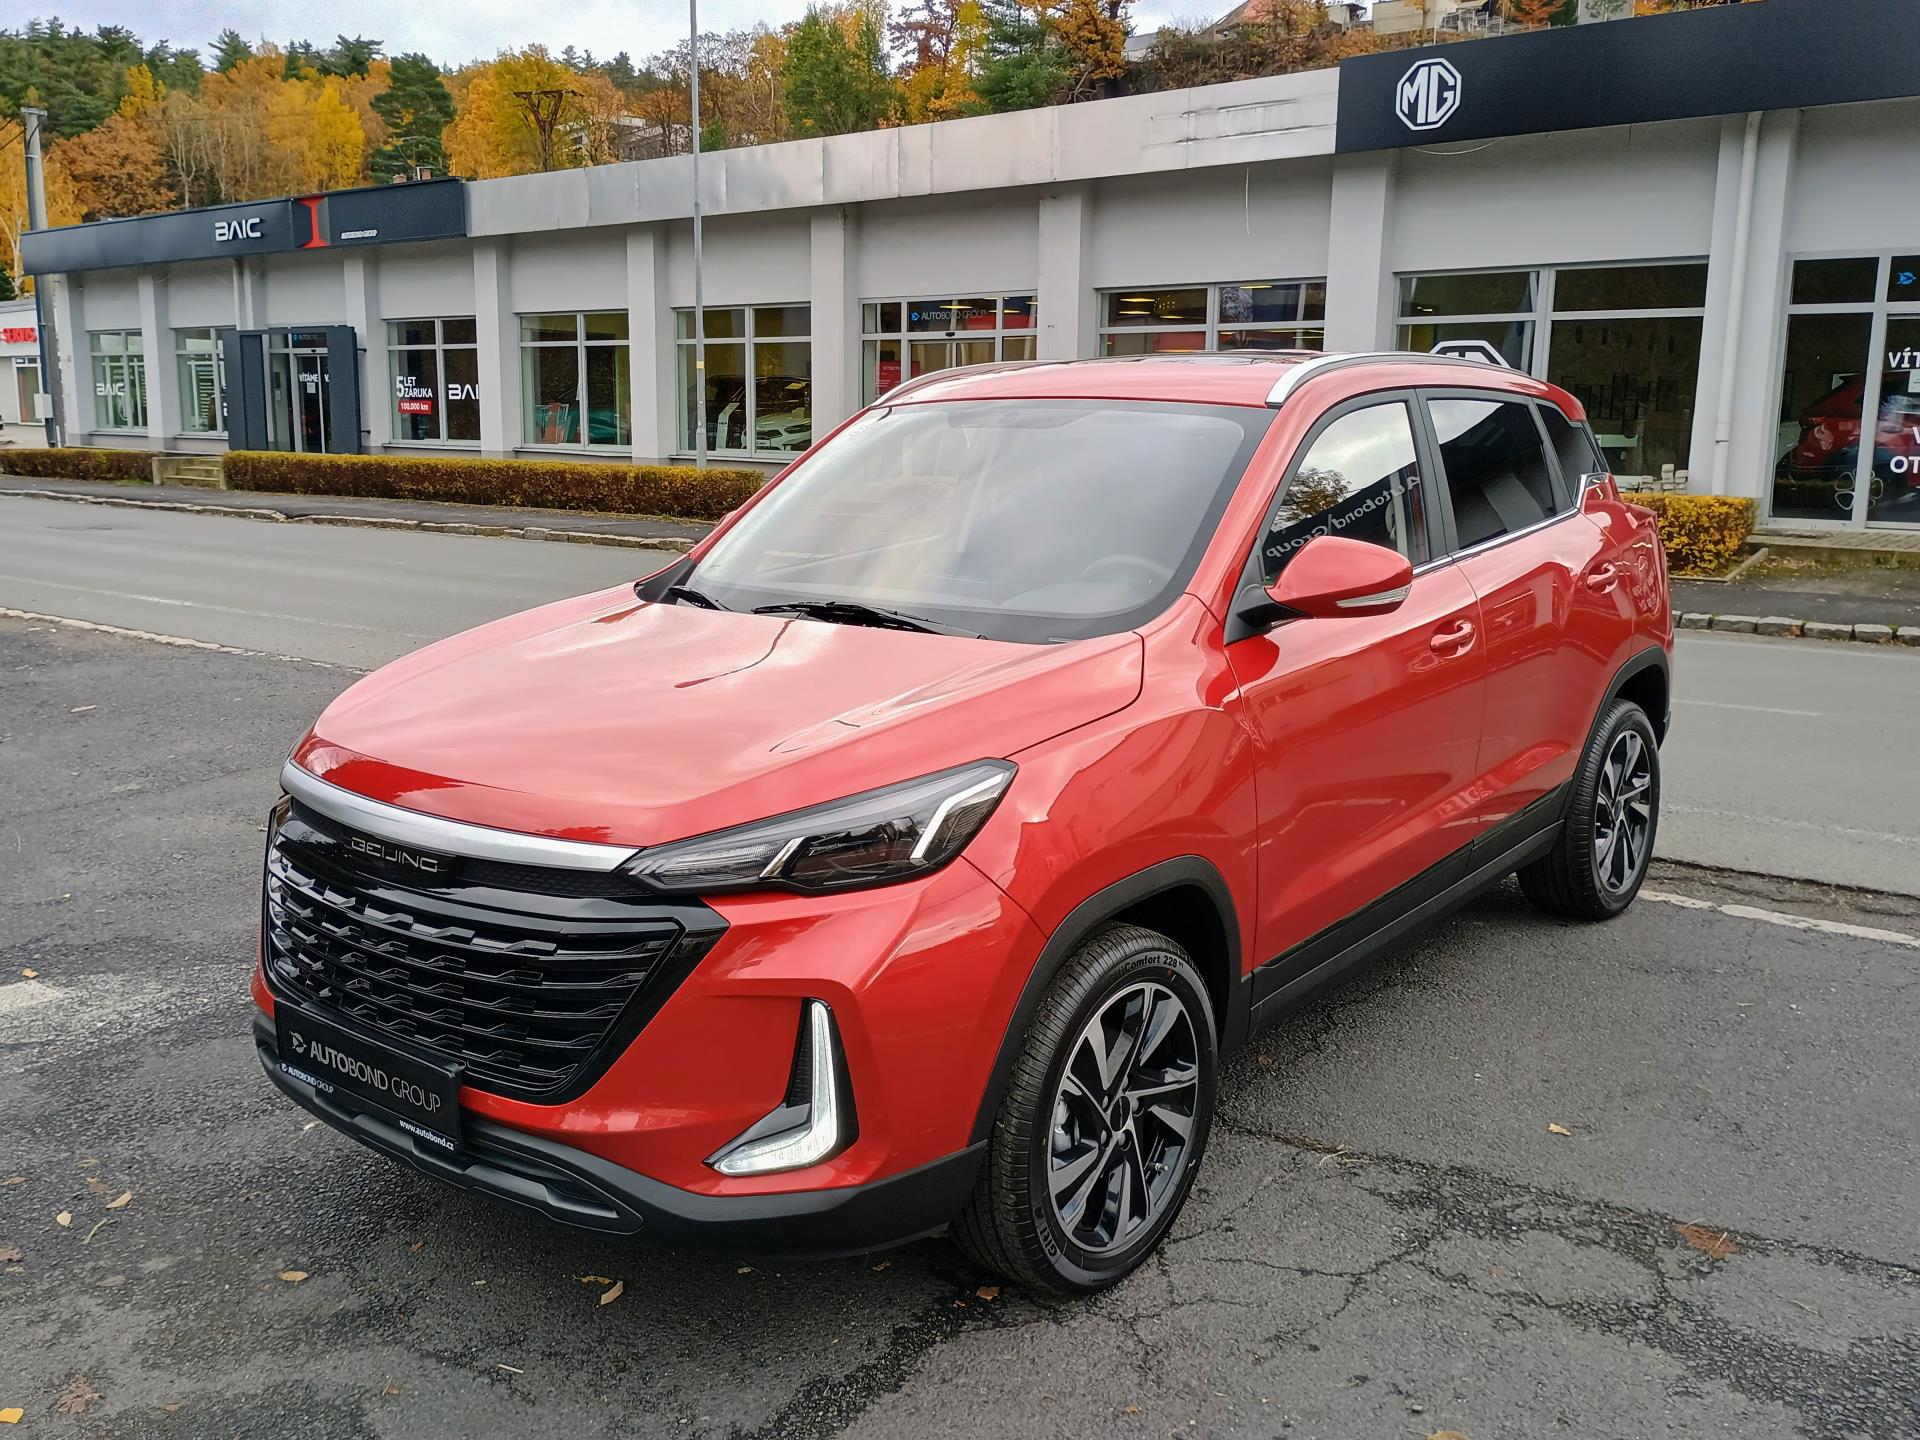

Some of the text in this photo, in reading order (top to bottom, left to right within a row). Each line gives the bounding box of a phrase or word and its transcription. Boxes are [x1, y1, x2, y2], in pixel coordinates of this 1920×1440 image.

[1400, 63, 1456, 125] MG
[214, 217, 262, 242] BAIC
[96, 383, 125, 396] BAIC
[396, 375, 404, 398] 5
[404, 376, 416, 387] LET
[352, 836, 438, 873] BEIJING
[1163, 955, 1178, 968] 228
[309, 1040, 441, 1113] AUTOBOND GROUP
[399, 1119, 455, 1151] www.autobond.cz
